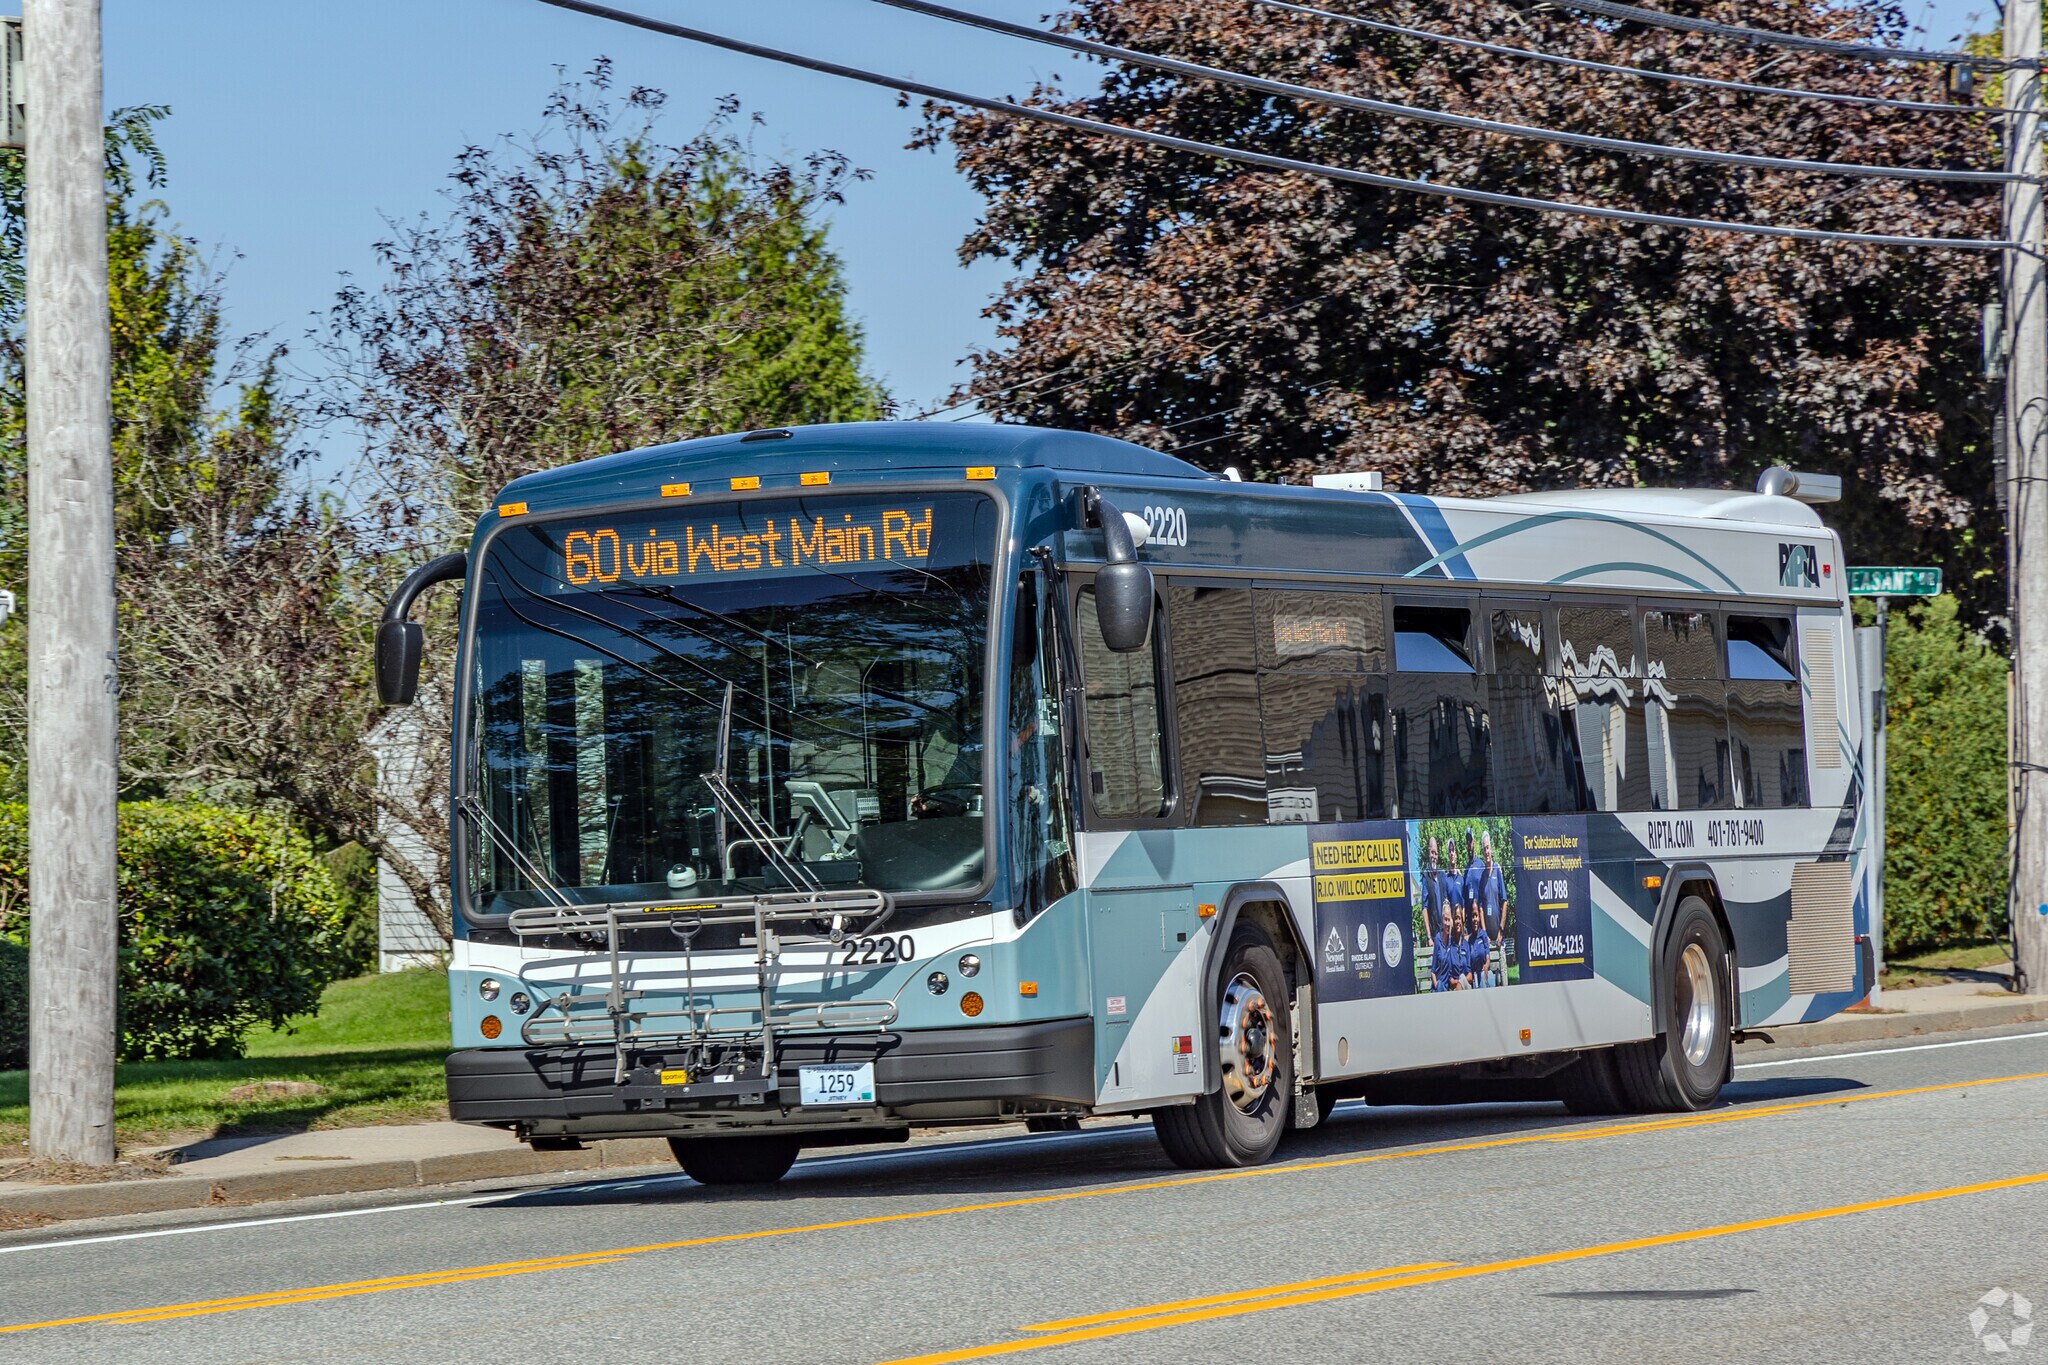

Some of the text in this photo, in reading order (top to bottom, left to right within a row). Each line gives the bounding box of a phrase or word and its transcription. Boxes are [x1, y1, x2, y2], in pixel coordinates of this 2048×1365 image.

[1144, 505, 1187, 547] 2220
[565, 508, 932, 585] 60 via West Main Rd
[1523, 834, 1578, 849] For Substance Use or
[1648, 819, 1764, 849] RIPTA.COM 401-781-9400
[1316, 843, 1400, 865] NEED HELP? CALL US
[1522, 855, 1582, 871] Mental Health Support
[1317, 877, 1404, 898] R.I.O. WILL COME TO YOU
[1538, 880, 1569, 900] Call 988
[1550, 914, 1559, 928] or
[841, 934, 915, 966] 2220
[1364, 953, 1376, 961] ISLAND
[1528, 934, 1584, 960] (401) 846-1213
[1326, 952, 1344, 964] Newport
[819, 1074, 854, 1093] 1259
